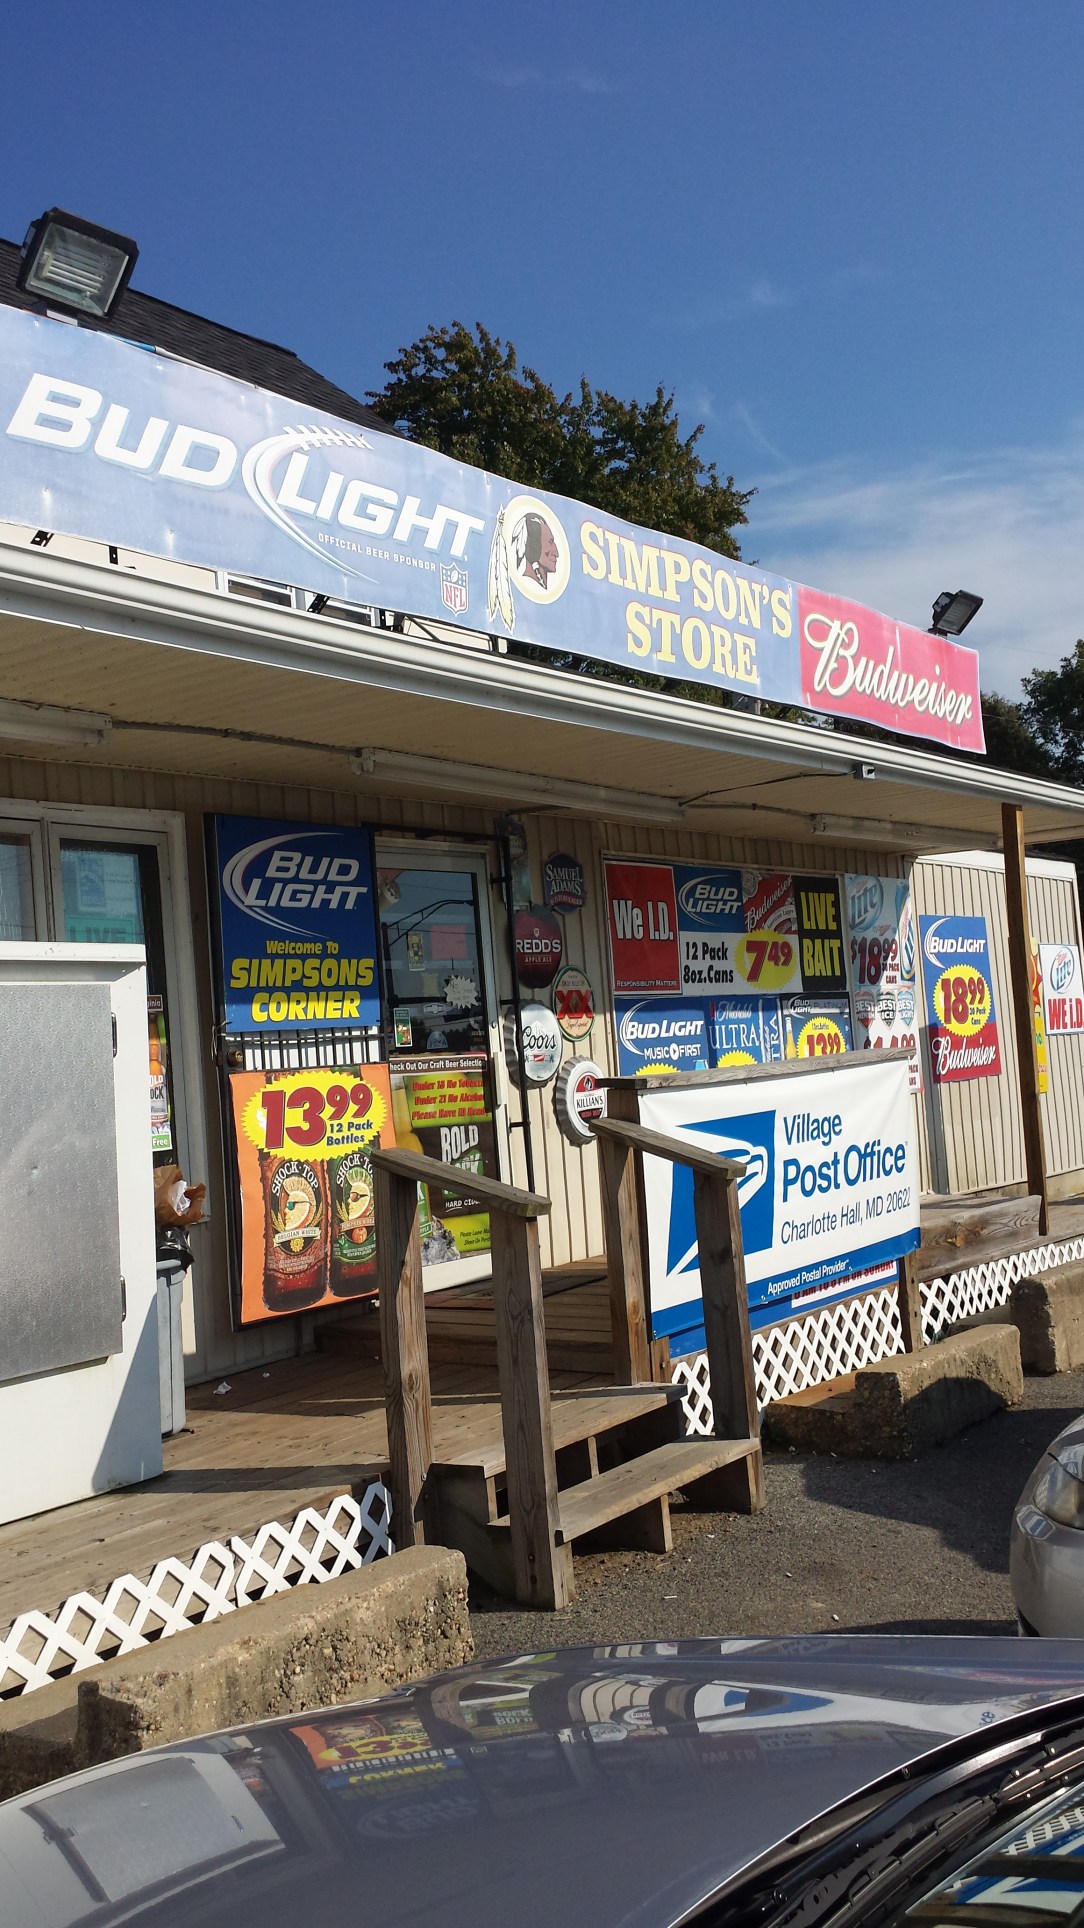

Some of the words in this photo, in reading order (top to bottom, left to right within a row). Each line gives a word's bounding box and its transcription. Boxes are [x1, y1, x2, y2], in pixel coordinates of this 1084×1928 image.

[6, 373, 238, 487] BUD
[275, 452, 485, 558] LIGHT
[318, 533, 362, 554] OFFICIAL
[366, 546, 390, 560] BEER
[393, 553, 437, 571] SPONSOR
[579, 520, 793, 638] SIMPSON'S
[444, 583, 466, 608] NFL
[624, 602, 760, 685] STORE
[803, 613, 974, 725] Budweiser
[265, 850, 360, 882] BUD
[546, 864, 583, 882] SAMUEL
[244, 878, 368, 910] LIGHT
[550, 878, 582, 896] ADAMS
[695, 884, 738, 900] BUD
[686, 900, 742, 914] LIGHT
[744, 875, 793, 932] Budweiser
[800, 891, 837, 931] LIVE
[613, 899, 644, 940] We
[647, 901, 674, 940] I.D.
[266, 940, 323, 954] Welcome
[686, 941, 698, 961] 12
[702, 941, 728, 961] Pack
[931, 936, 957, 953] BUD
[957, 937, 987, 953] LIGHT
[802, 939, 841, 977] BAIT
[230, 958, 375, 988] SIMPSONS
[683, 964, 734, 984] 8oz.Cans
[147, 998, 161, 1007] ginia
[252, 990, 360, 1022] CORNER
[556, 990, 594, 1019] XX
[855, 1001, 875, 1012] BEST
[877, 1000, 896, 1011] BEST
[898, 1000, 914, 1010] BEST
[969, 1007, 976, 1015] 30
[976, 1006, 986, 1015] Pack
[881, 1011, 894, 1020] ICE
[1047, 998, 1068, 1030] WE
[522, 1025, 557, 1051] Coors
[626, 1020, 660, 1040] BUD
[660, 1019, 704, 1038] LIGHT
[709, 1023, 760, 1050] ULTRA
[644, 1046, 671, 1061] MUSIC
[679, 1043, 702, 1058] FIRST
[932, 1036, 996, 1076] Budweiser
[390, 1062, 404, 1071] heck
[406, 1062, 417, 1071] Out
[418, 1062, 428, 1070] Our
[430, 1060, 444, 1069] Craft
[446, 1060, 459, 1068] Beer
[149, 1074, 164, 1087] OLD
[412, 1081, 436, 1092] Under
[446, 1080, 457, 1089] No
[150, 1085, 164, 1100] OCK
[414, 1096, 438, 1106] Under
[448, 1094, 458, 1103] No
[576, 1096, 604, 1108] KILLIAN'S
[412, 1110, 437, 1120] Please
[438, 1109, 457, 1118] Have
[458, 1108, 466, 1117] ID
[330, 1122, 344, 1134] 12
[347, 1120, 374, 1133] Pack
[783, 1112, 843, 1147] Village
[152, 1138, 168, 1147] Free
[326, 1132, 366, 1147] Bottles
[440, 1124, 480, 1166] BOLD
[782, 1150, 841, 1203] Post
[843, 1139, 906, 1187] Office
[446, 1200, 462, 1208] HARD
[780, 1210, 838, 1245] Charlotte
[840, 1203, 864, 1229] Hall,
[865, 1195, 884, 1220] MD
[278, 1230, 300, 1242] BELGIAN
[767, 1273, 800, 1296] Approved
[801, 1266, 822, 1284] Postal
[822, 1260, 847, 1278] Provider
